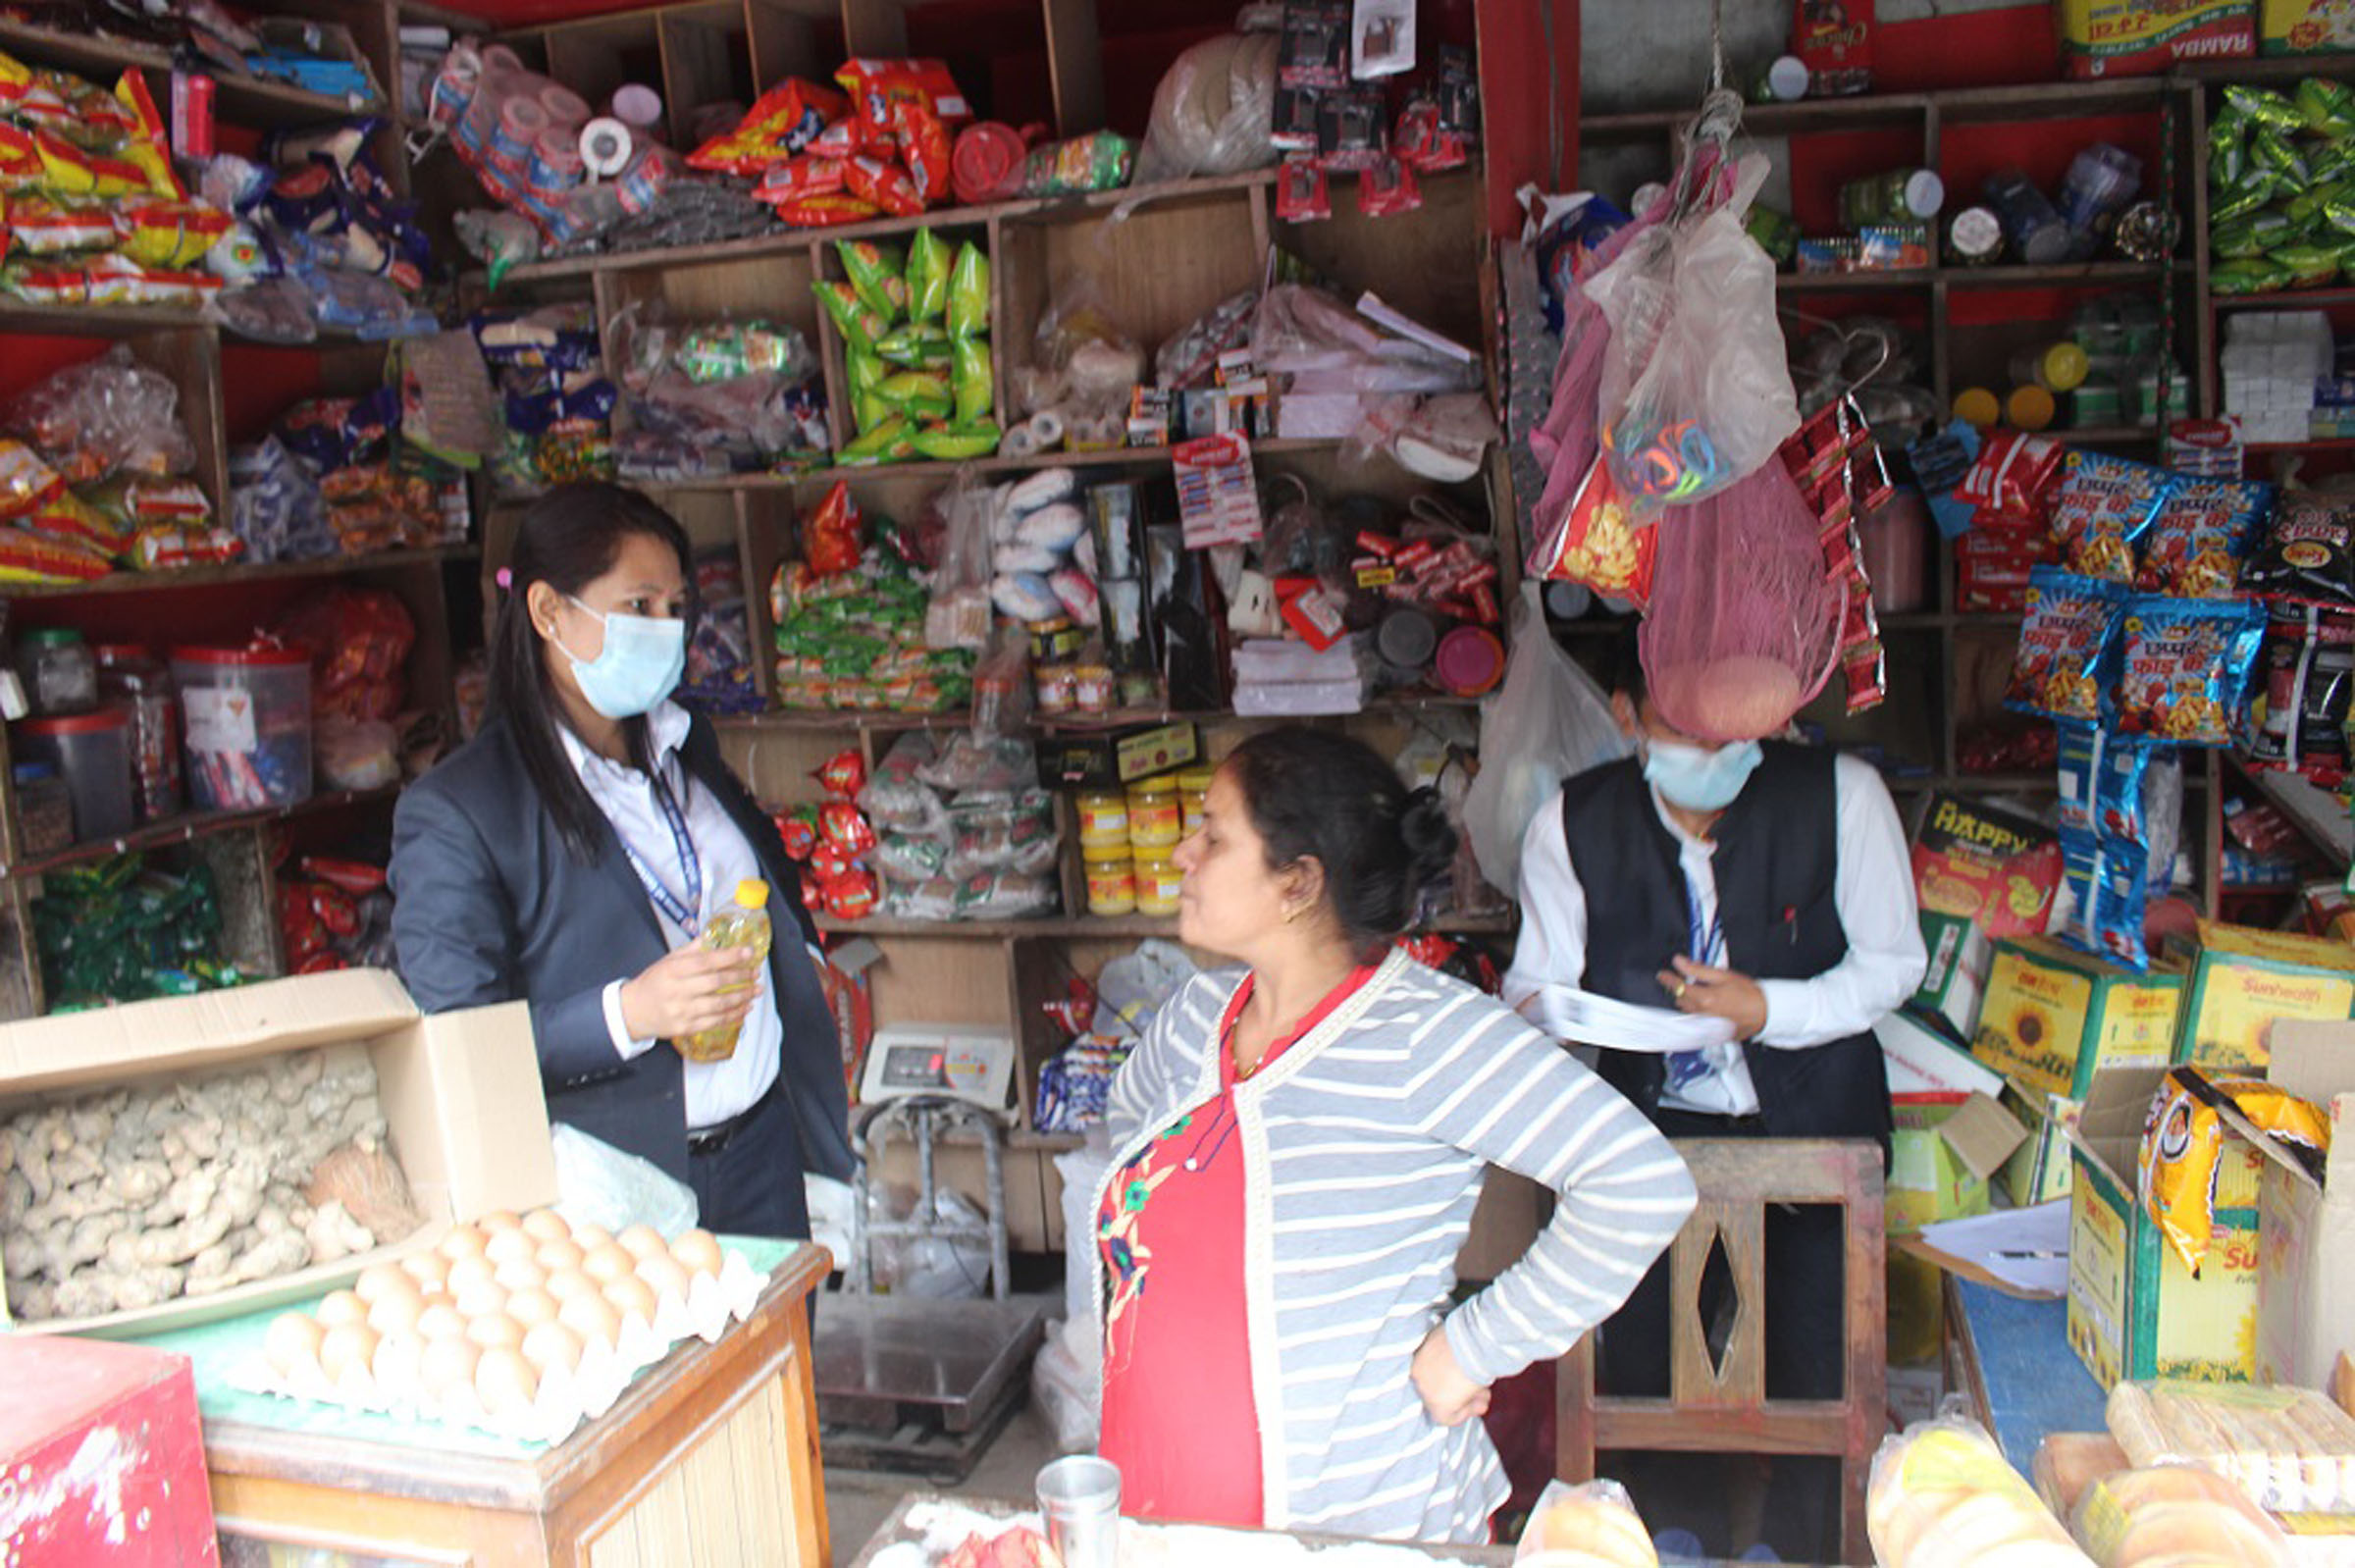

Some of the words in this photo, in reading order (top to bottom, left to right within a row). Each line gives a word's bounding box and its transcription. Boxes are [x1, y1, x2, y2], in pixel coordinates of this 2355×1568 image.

[2171, 32, 2248, 59] RAMBA
[1934, 800, 2028, 856] HAPPY
[2242, 976, 2322, 1005] Sunhealth
